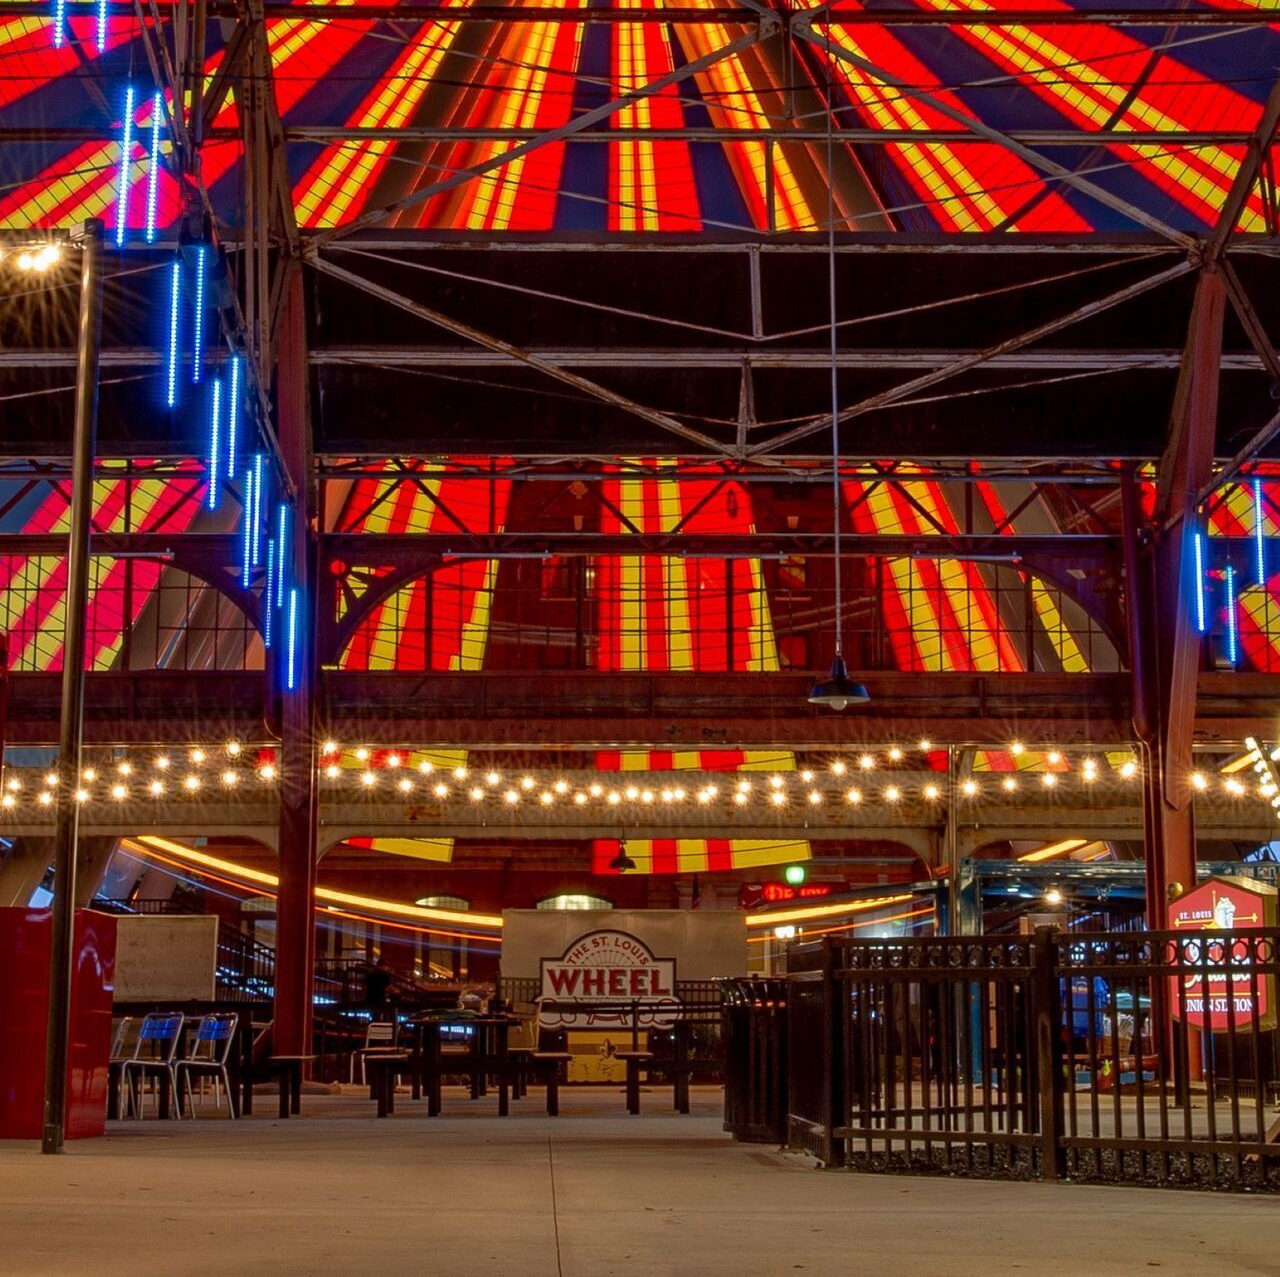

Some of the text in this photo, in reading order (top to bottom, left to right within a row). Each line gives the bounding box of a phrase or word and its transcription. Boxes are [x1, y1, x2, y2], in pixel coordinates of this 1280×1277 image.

[567, 935, 651, 965] THE ST. LOUIS
[546, 968, 671, 995] WHEEL
